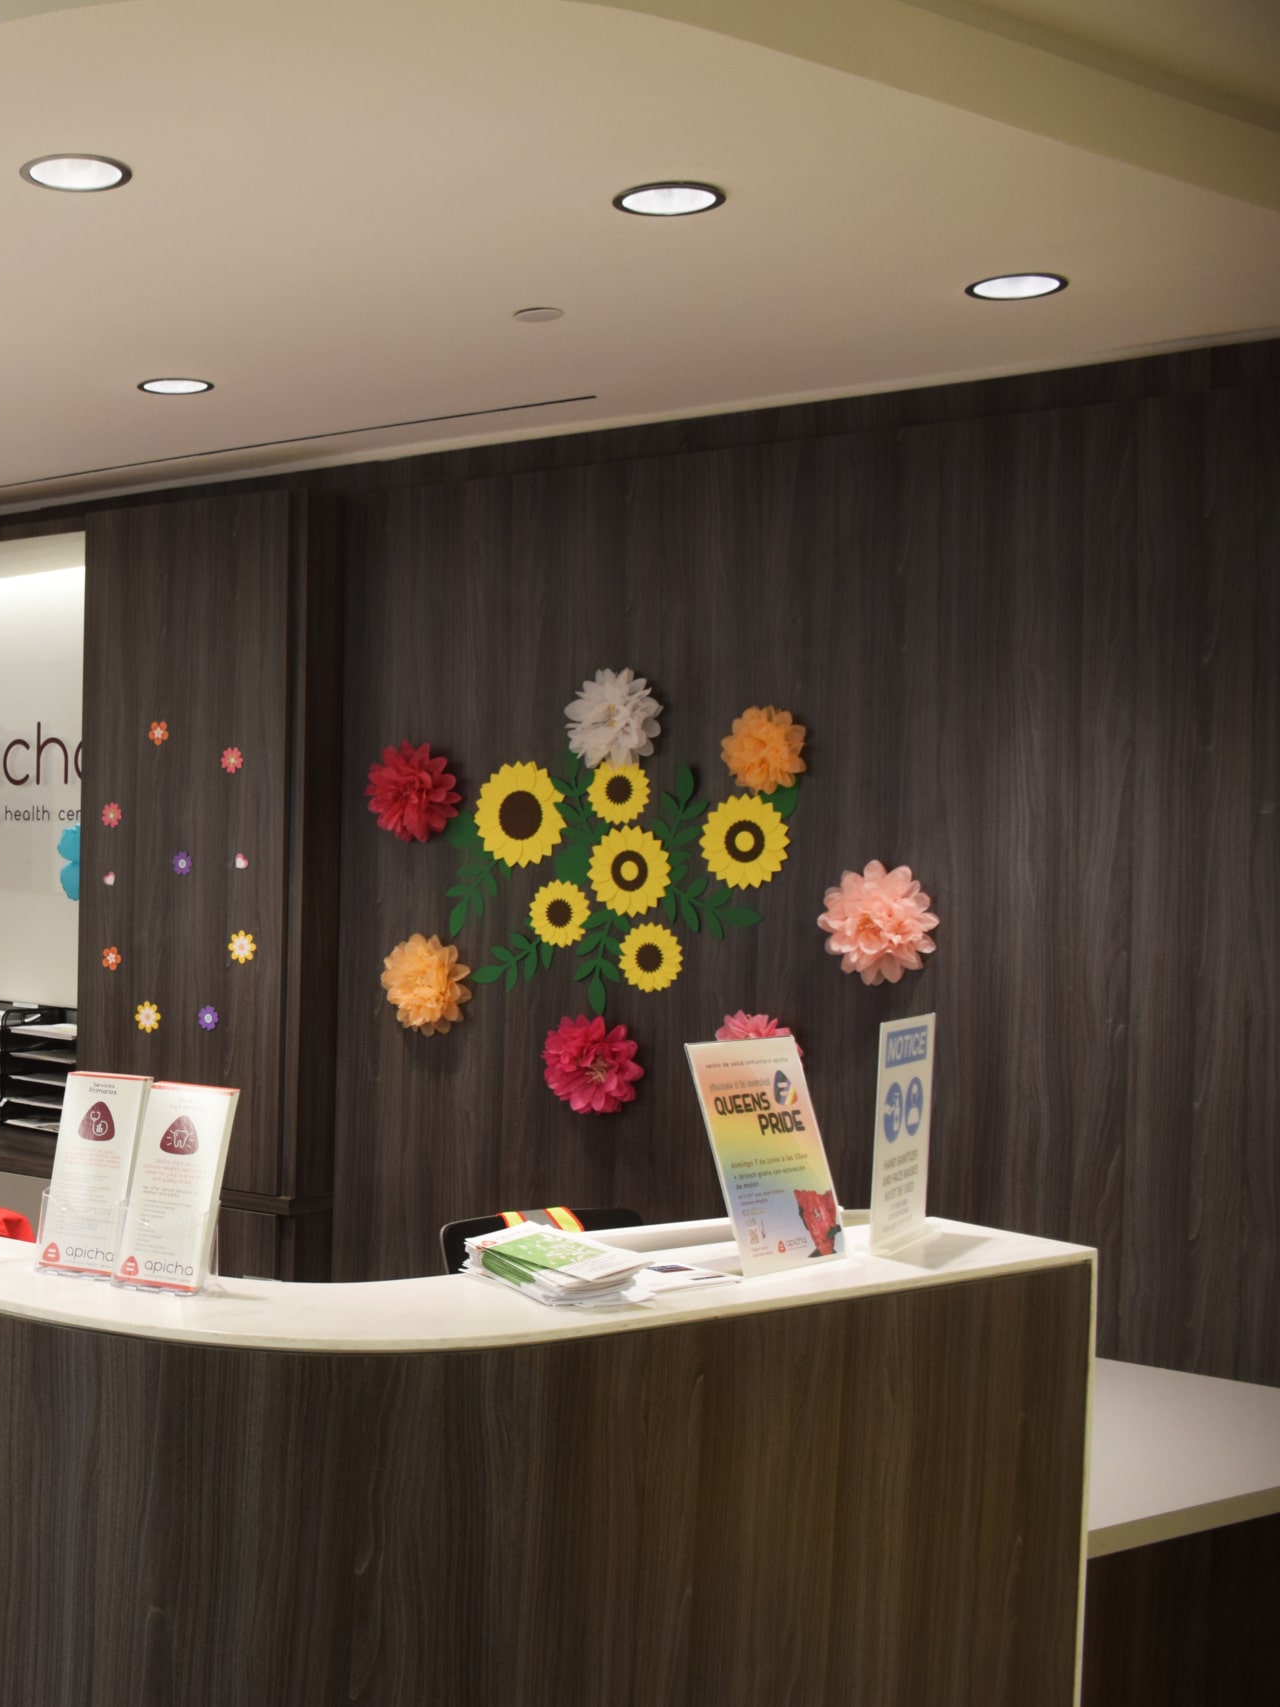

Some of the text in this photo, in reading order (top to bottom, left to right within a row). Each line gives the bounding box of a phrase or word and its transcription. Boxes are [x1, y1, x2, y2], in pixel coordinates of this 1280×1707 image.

[4, 804, 51, 821] health
[887, 1029, 927, 1062] NOTICE
[714, 1092, 771, 1116] QUEENS
[758, 1110, 805, 1135] PRIDE
[65, 1245, 114, 1263] apicha
[144, 1259, 194, 1277] apicha
